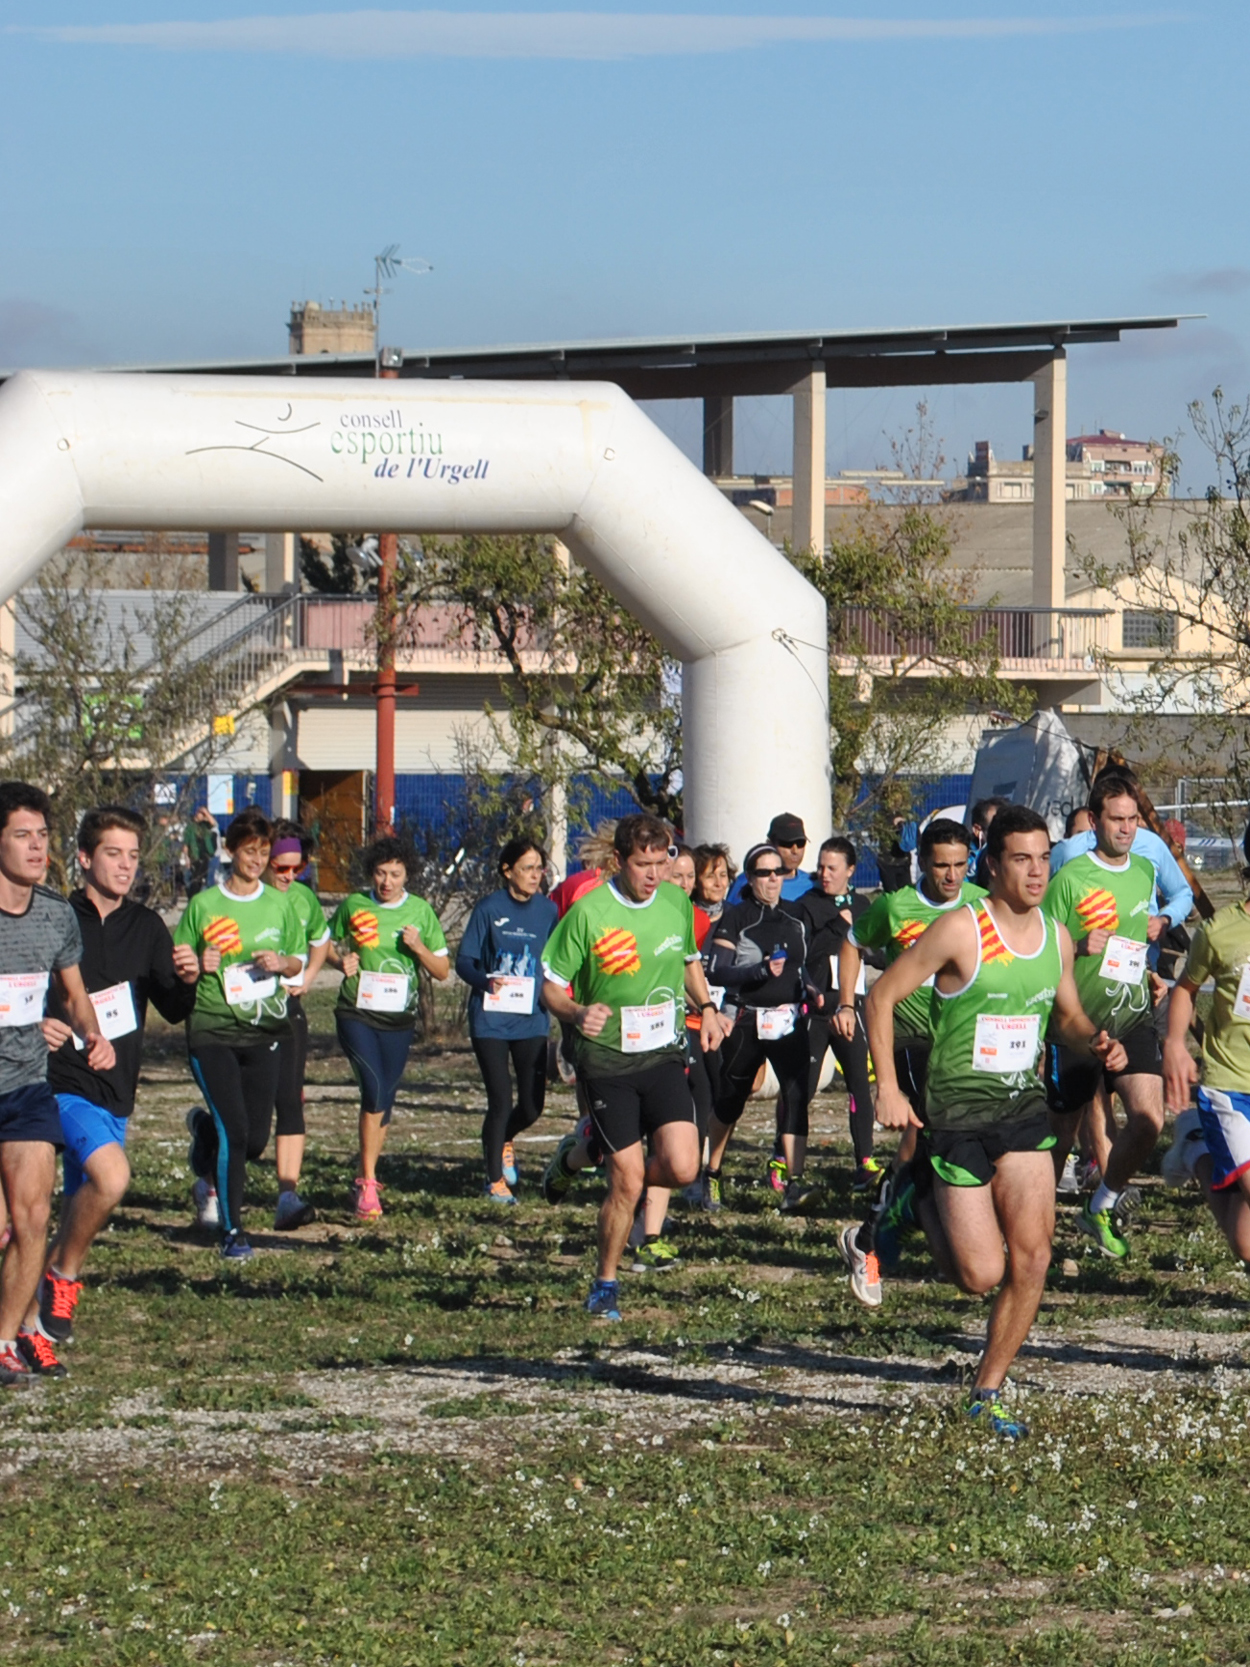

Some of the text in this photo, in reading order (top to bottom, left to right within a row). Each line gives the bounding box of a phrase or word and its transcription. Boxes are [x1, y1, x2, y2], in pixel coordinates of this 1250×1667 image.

[340, 410, 402, 428] consell
[331, 422, 443, 464] esportiu
[374, 457, 490, 485] de l'Urgell
[1010, 1041, 1026, 1049] 291
